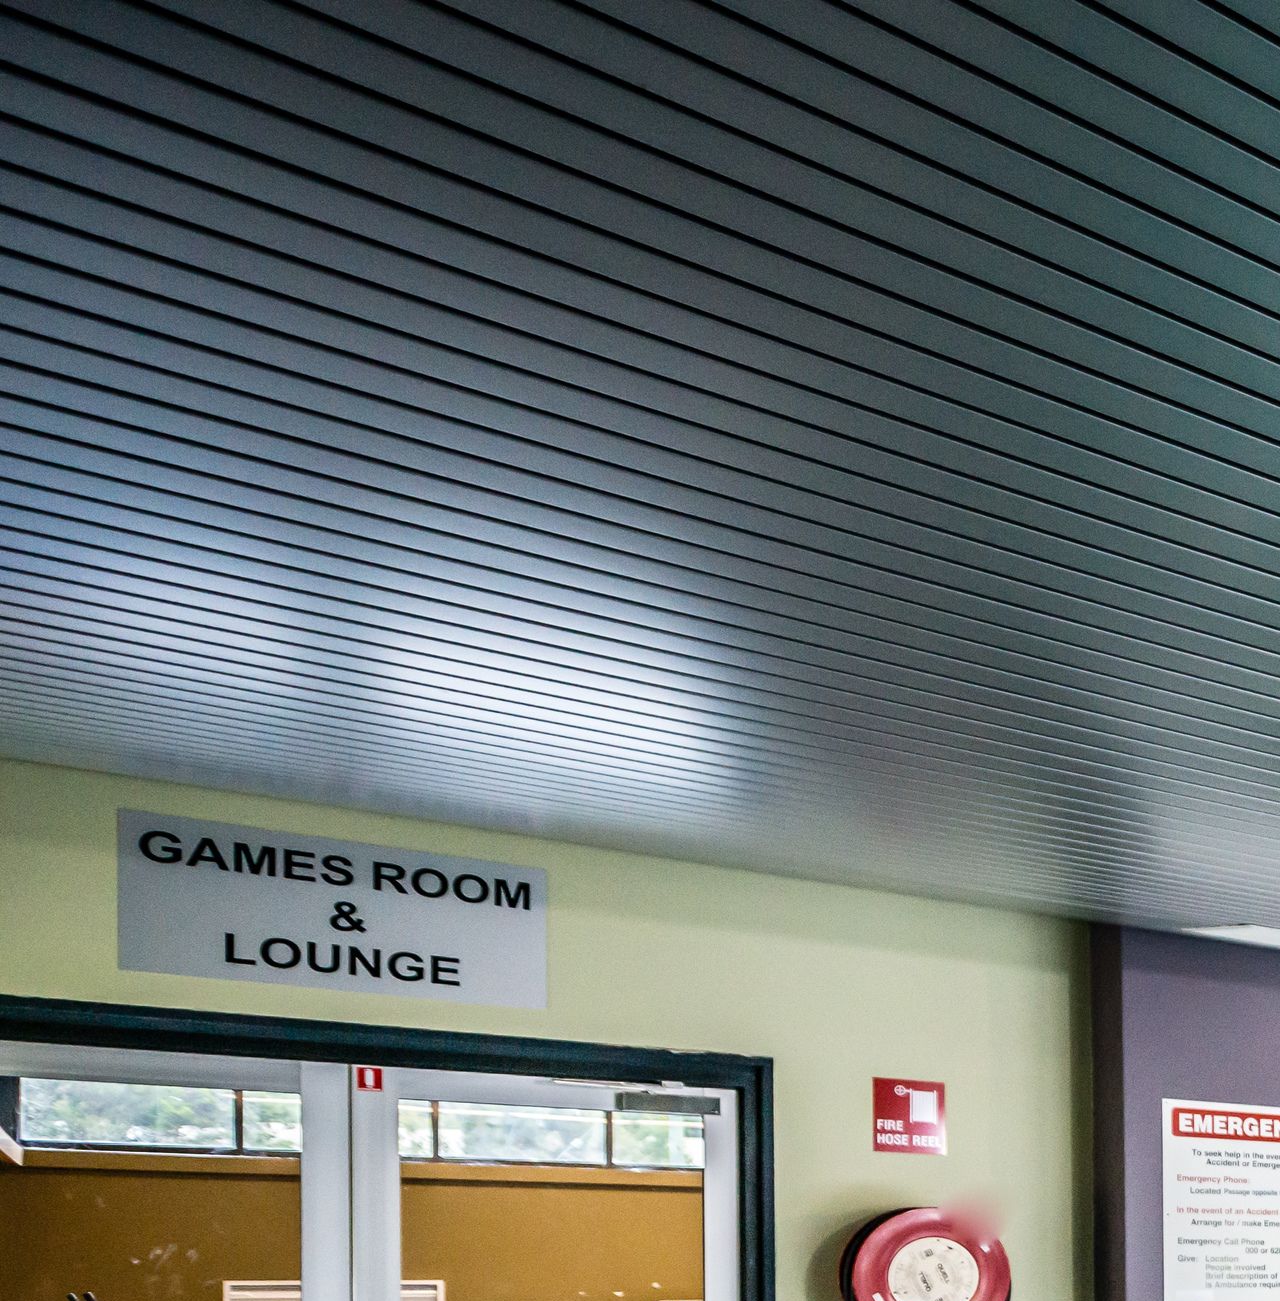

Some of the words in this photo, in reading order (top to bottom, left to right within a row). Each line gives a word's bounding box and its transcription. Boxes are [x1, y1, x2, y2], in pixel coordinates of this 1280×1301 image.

[138, 830, 354, 886] GAMES
[373, 860, 532, 910] ROOM
[329, 900, 367, 933] &
[224, 932, 461, 987] LOUNGE
[876, 1118, 904, 1132] FIRE
[876, 1132, 909, 1146] HOSE
[912, 1134, 942, 1148] REEL
[1192, 1148, 1202, 1157] To
[1225, 1151, 1241, 1159] help
[1206, 1158, 1240, 1166] Accident
[1176, 1173, 1221, 1184] Emergency
[1190, 1186, 1221, 1195] Located
[1246, 1207, 1279, 1215] Accident
[1191, 1218, 1222, 1228] Arrange
[1242, 1219, 1262, 1227] make
[1177, 1237, 1222, 1247] Emergency
[1223, 1237, 1239, 1245] Call
[1241, 1237, 1265, 1246] Phone
[1177, 1254, 1198, 1262] Give:
[1205, 1264, 1232, 1272] People
[1205, 1272, 1224, 1280] Brief
[1226, 1273, 1269, 1281] description
